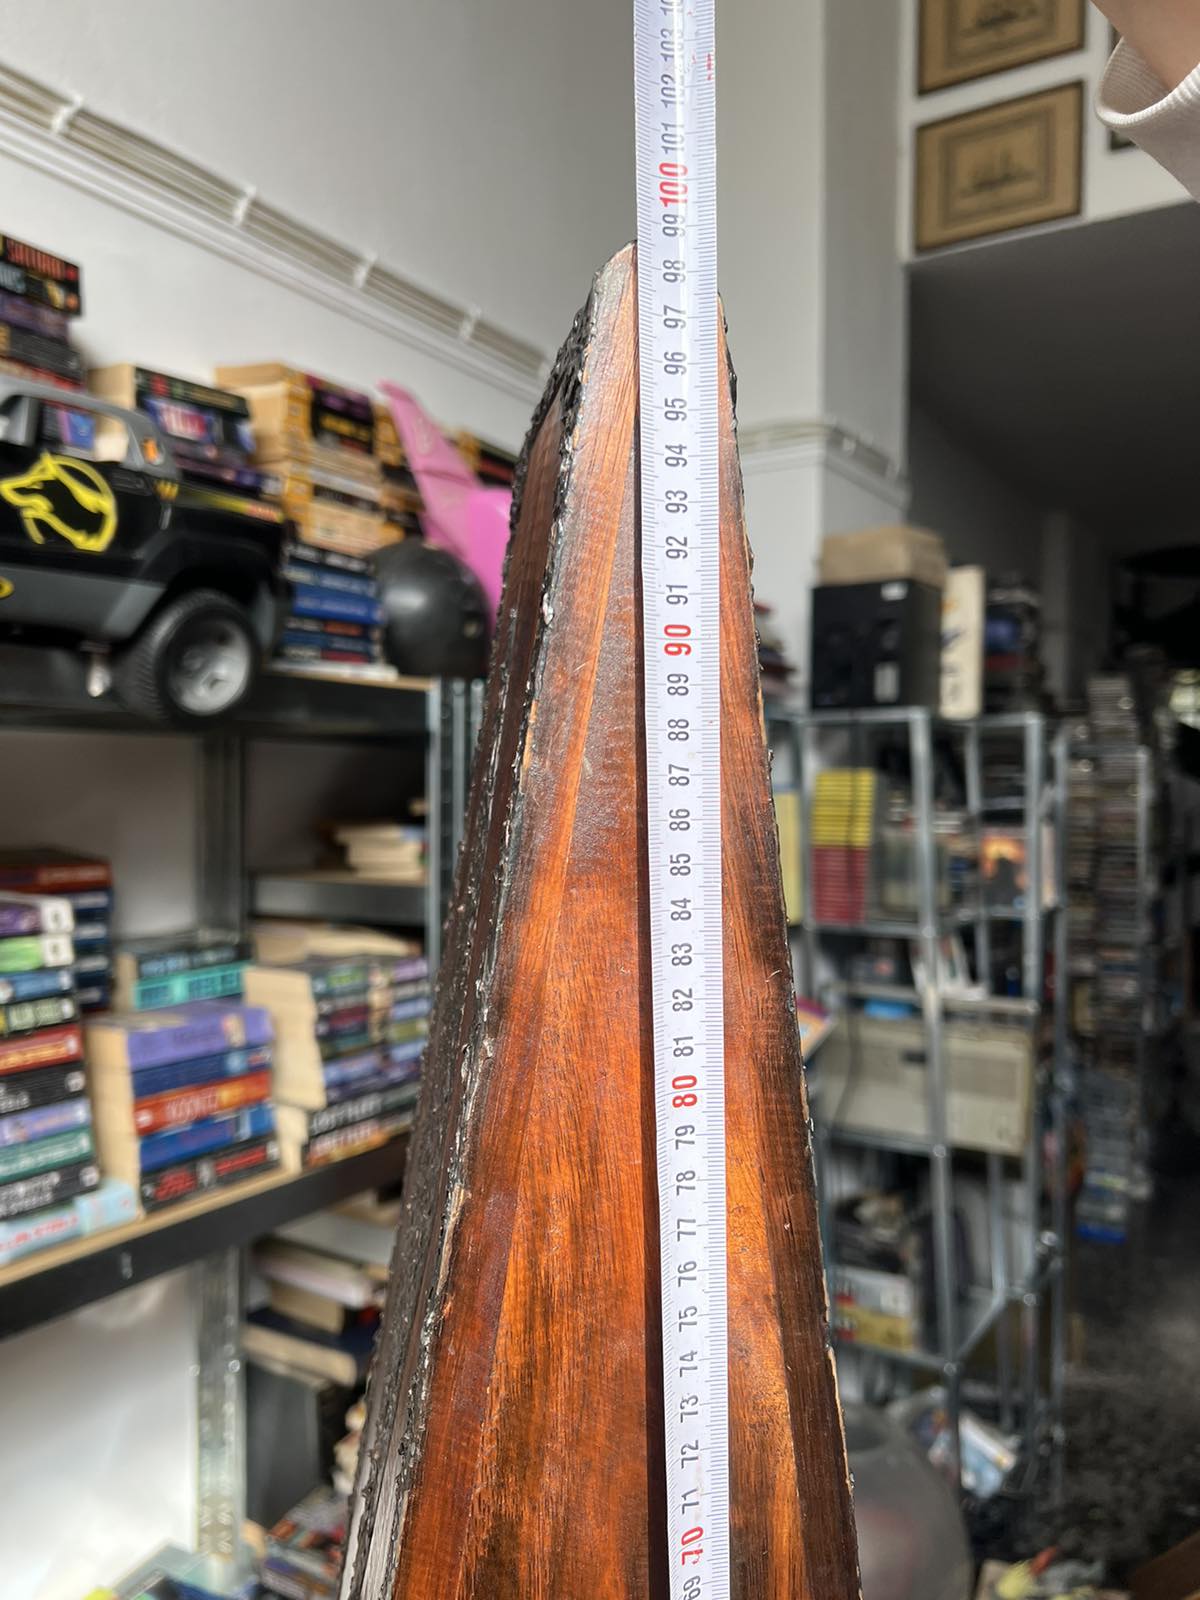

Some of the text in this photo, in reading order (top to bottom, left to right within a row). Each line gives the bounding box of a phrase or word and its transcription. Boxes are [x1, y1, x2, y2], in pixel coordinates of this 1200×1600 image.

[660, 28, 684, 62] 103
[661, 74, 684, 108] 102
[661, 123, 685, 154] 101
[659, 163, 688, 207] 100
[662, 214, 685, 237] 99
[663, 260, 686, 283] 98
[664, 305, 686, 328] 97
[664, 352, 686, 375] 96
[665, 398, 686, 420] 95
[665, 445, 687, 467] 94
[665, 491, 687, 513] 93
[666, 536, 688, 559] 92
[666, 585, 688, 604] 91
[664, 624, 691, 656] 90
[667, 674, 689, 696] 89
[668, 719, 689, 741] 88
[669, 764, 689, 786] 87
[669, 809, 690, 831] 86
[670, 854, 691, 876] 85
[671, 898, 691, 921] 84
[671, 943, 692, 966] 83
[672, 988, 693, 1011] 82
[673, 1037, 693, 1057] 81
[672, 1075, 697, 1108] 80
[675, 1125, 695, 1150] 79
[676, 1171, 695, 1196] 78
[677, 1219, 696, 1242] 77
[678, 1261, 697, 1287] 76
[679, 1306, 697, 1332] 75
[680, 1351, 697, 1377] 74
[680, 1396, 698, 1423] 73
[681, 1440, 698, 1469] 72
[682, 1489, 699, 1514] 71
[681, 1527, 703, 1565] 70
